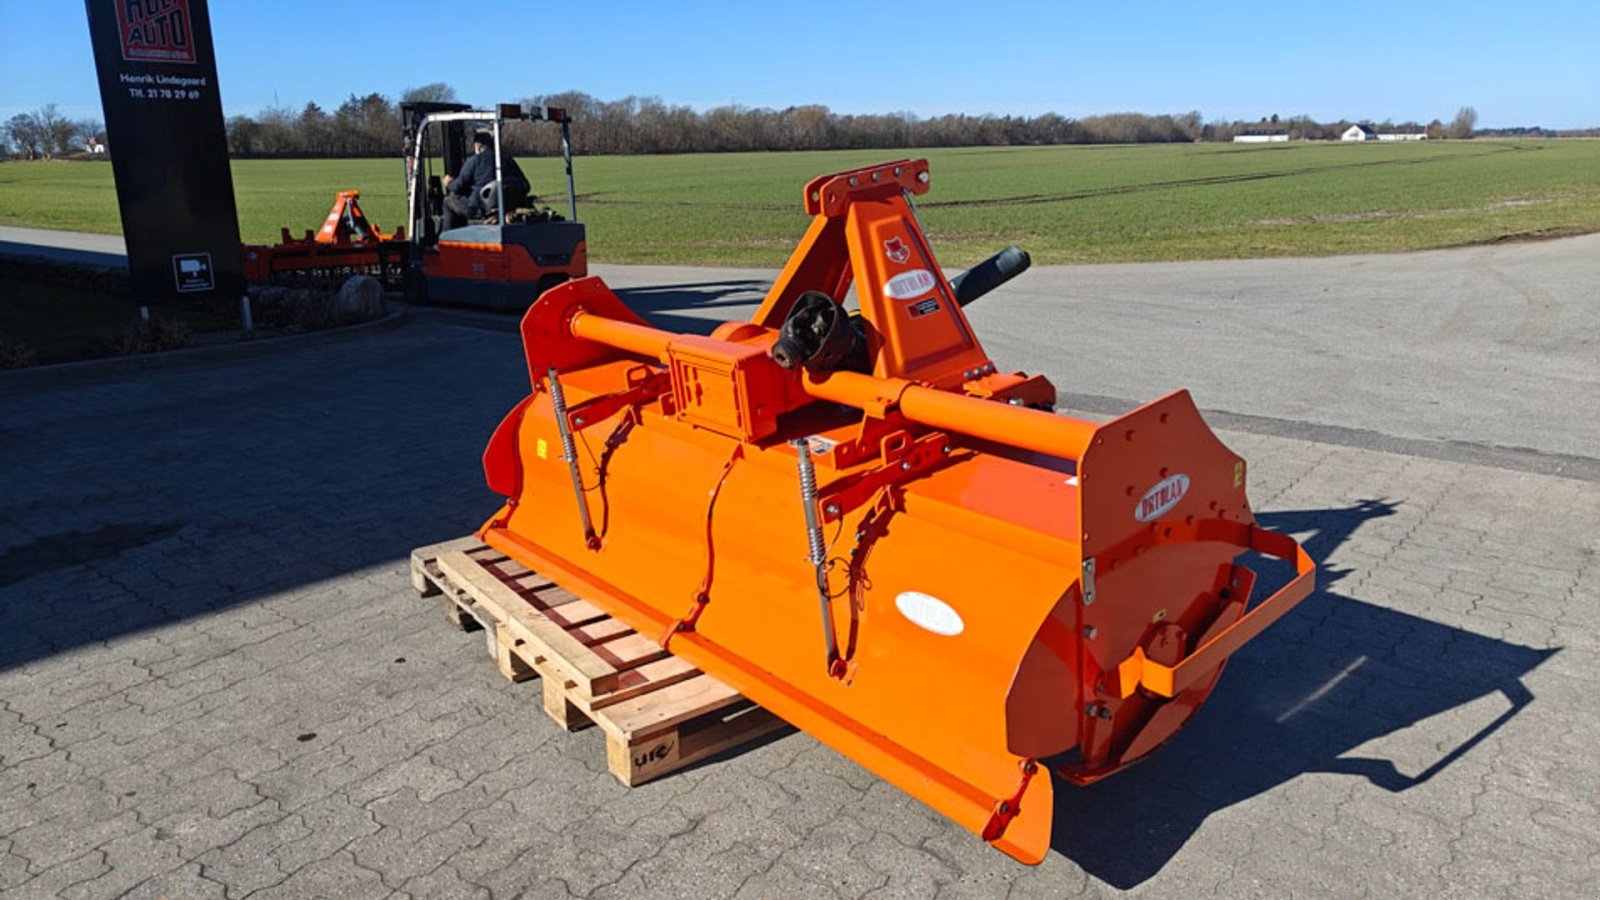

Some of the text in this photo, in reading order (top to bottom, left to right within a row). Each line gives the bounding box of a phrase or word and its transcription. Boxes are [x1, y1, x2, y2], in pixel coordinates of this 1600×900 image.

[128, 9, 188, 47] AUTO
[119, 73, 206, 87] Henrik Lindegaard
[147, 89, 158, 98] 21
